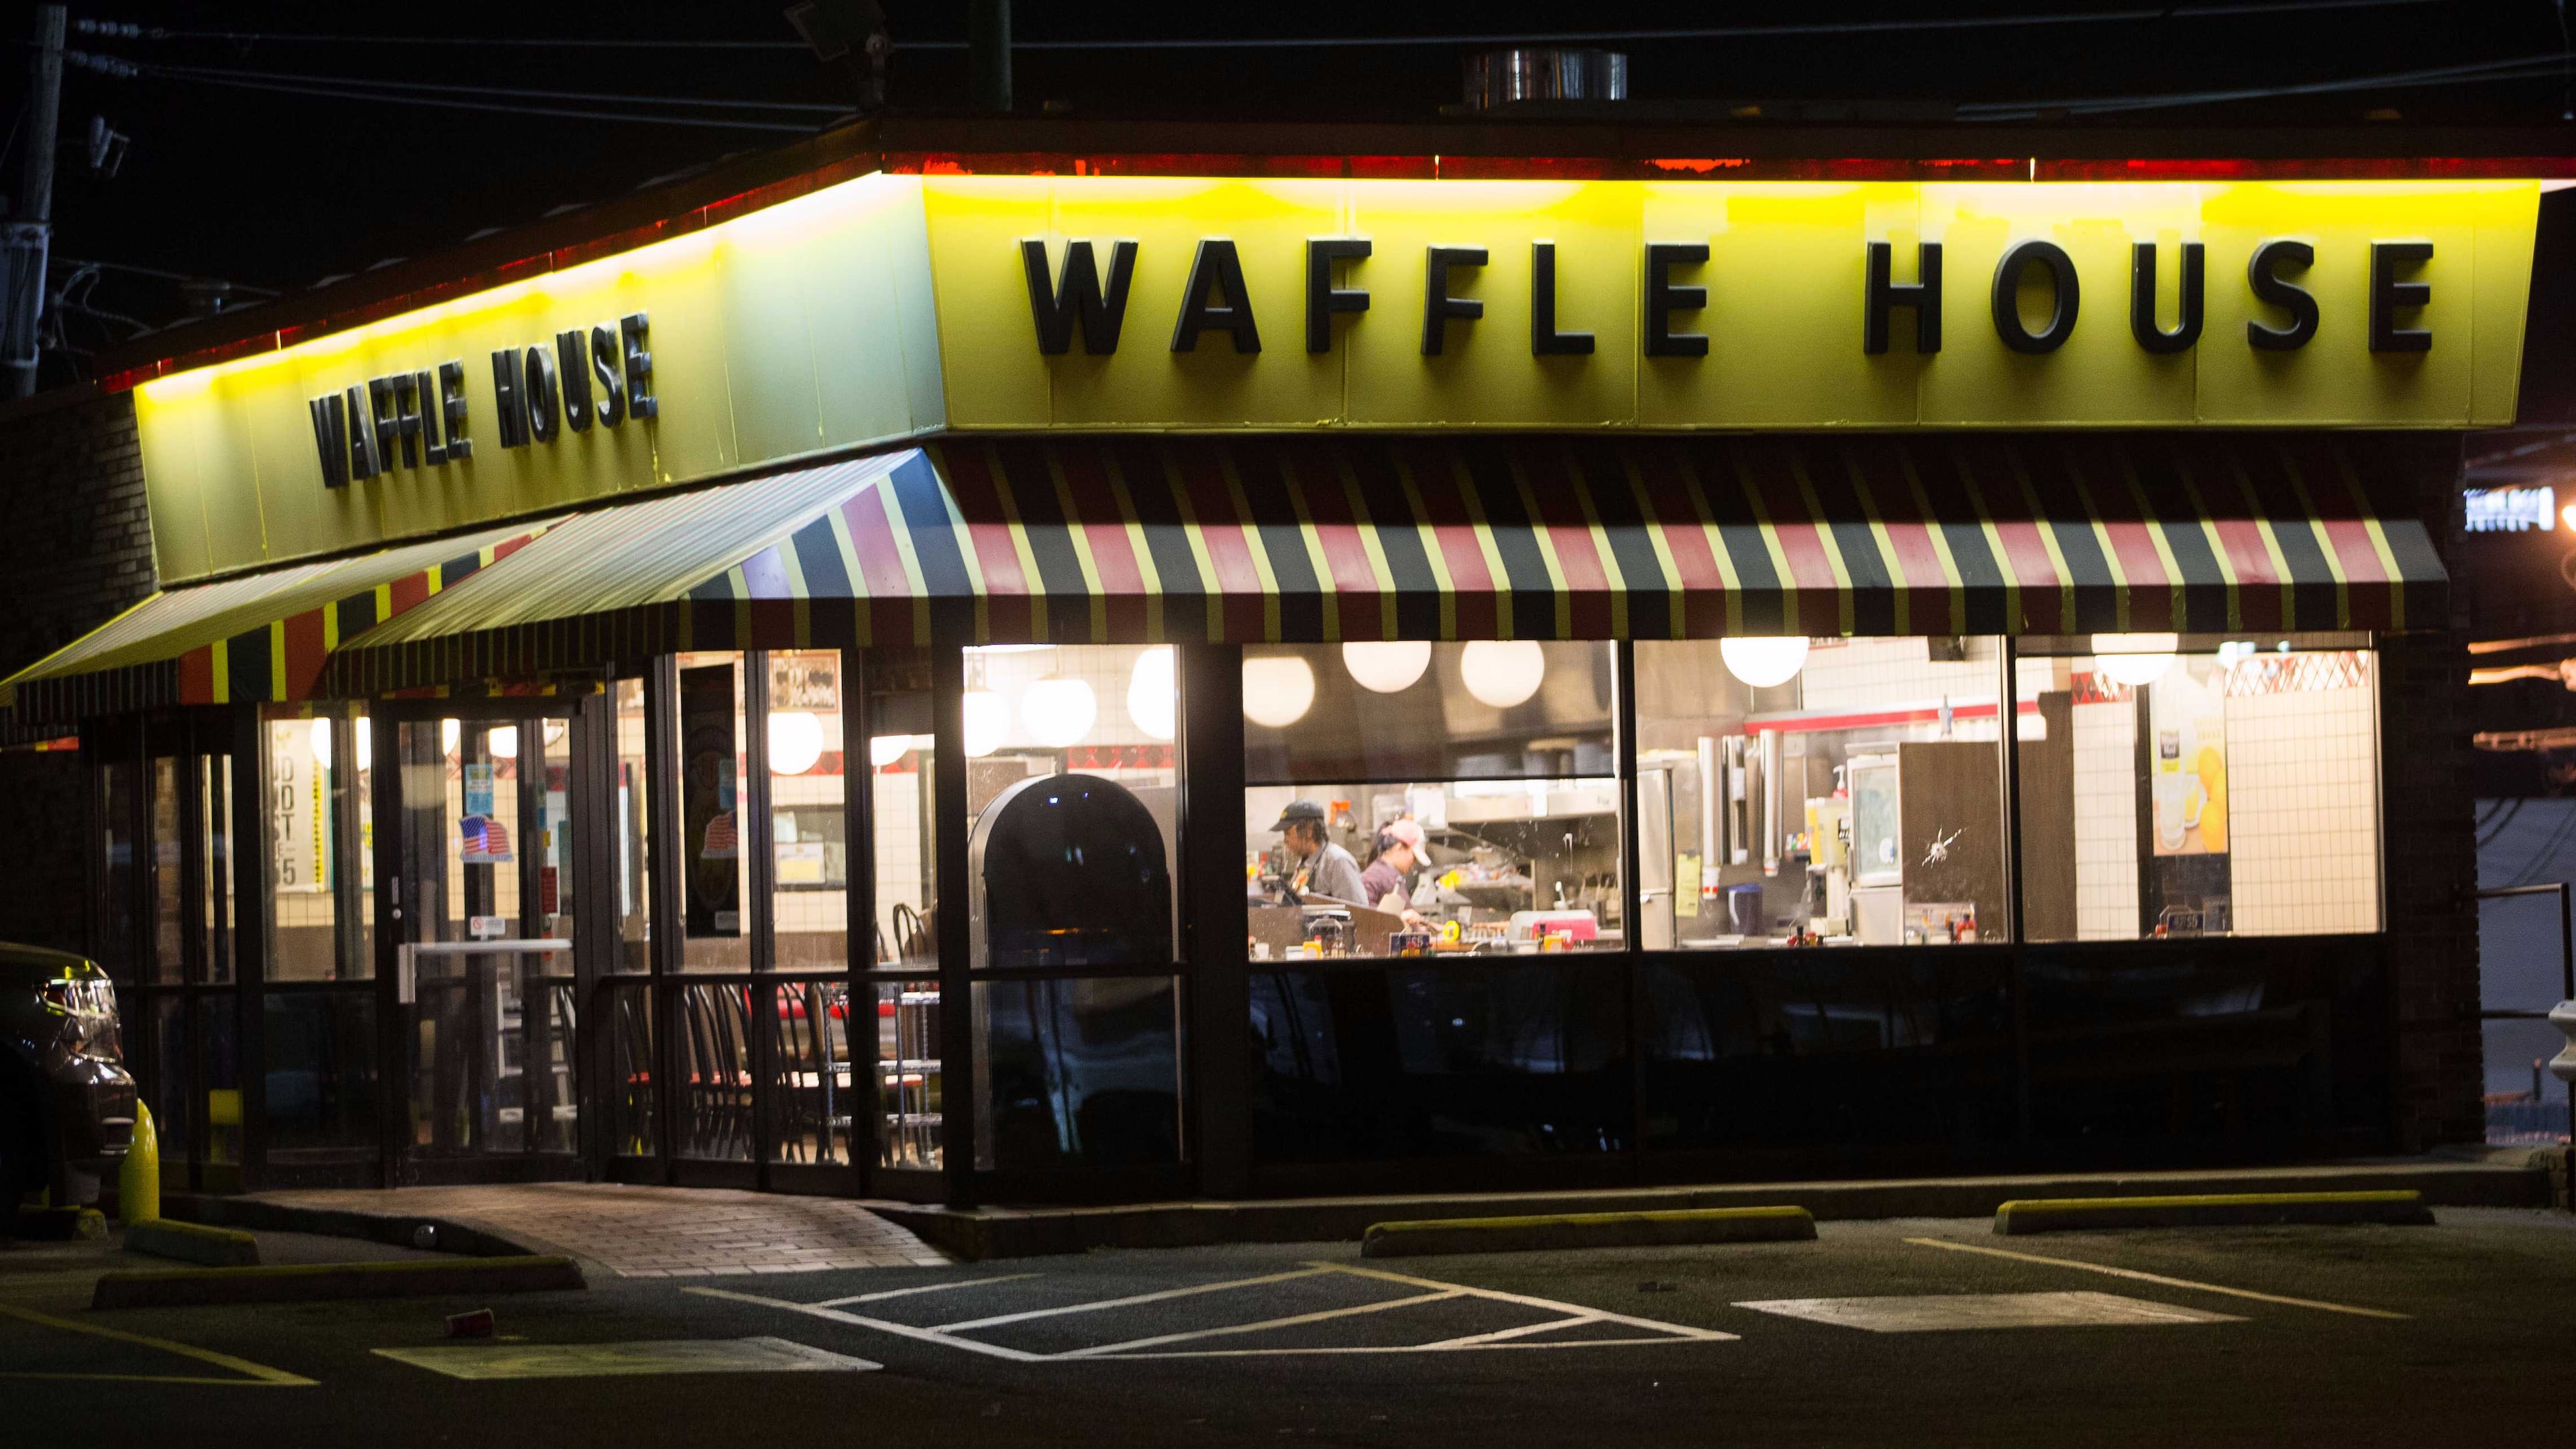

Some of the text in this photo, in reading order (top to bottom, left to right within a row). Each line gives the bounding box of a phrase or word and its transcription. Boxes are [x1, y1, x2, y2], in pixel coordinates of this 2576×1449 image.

[1020, 237, 2434, 356] WAFFLE HOUSE
[309, 310, 658, 488] WAFFLE HOUSE
